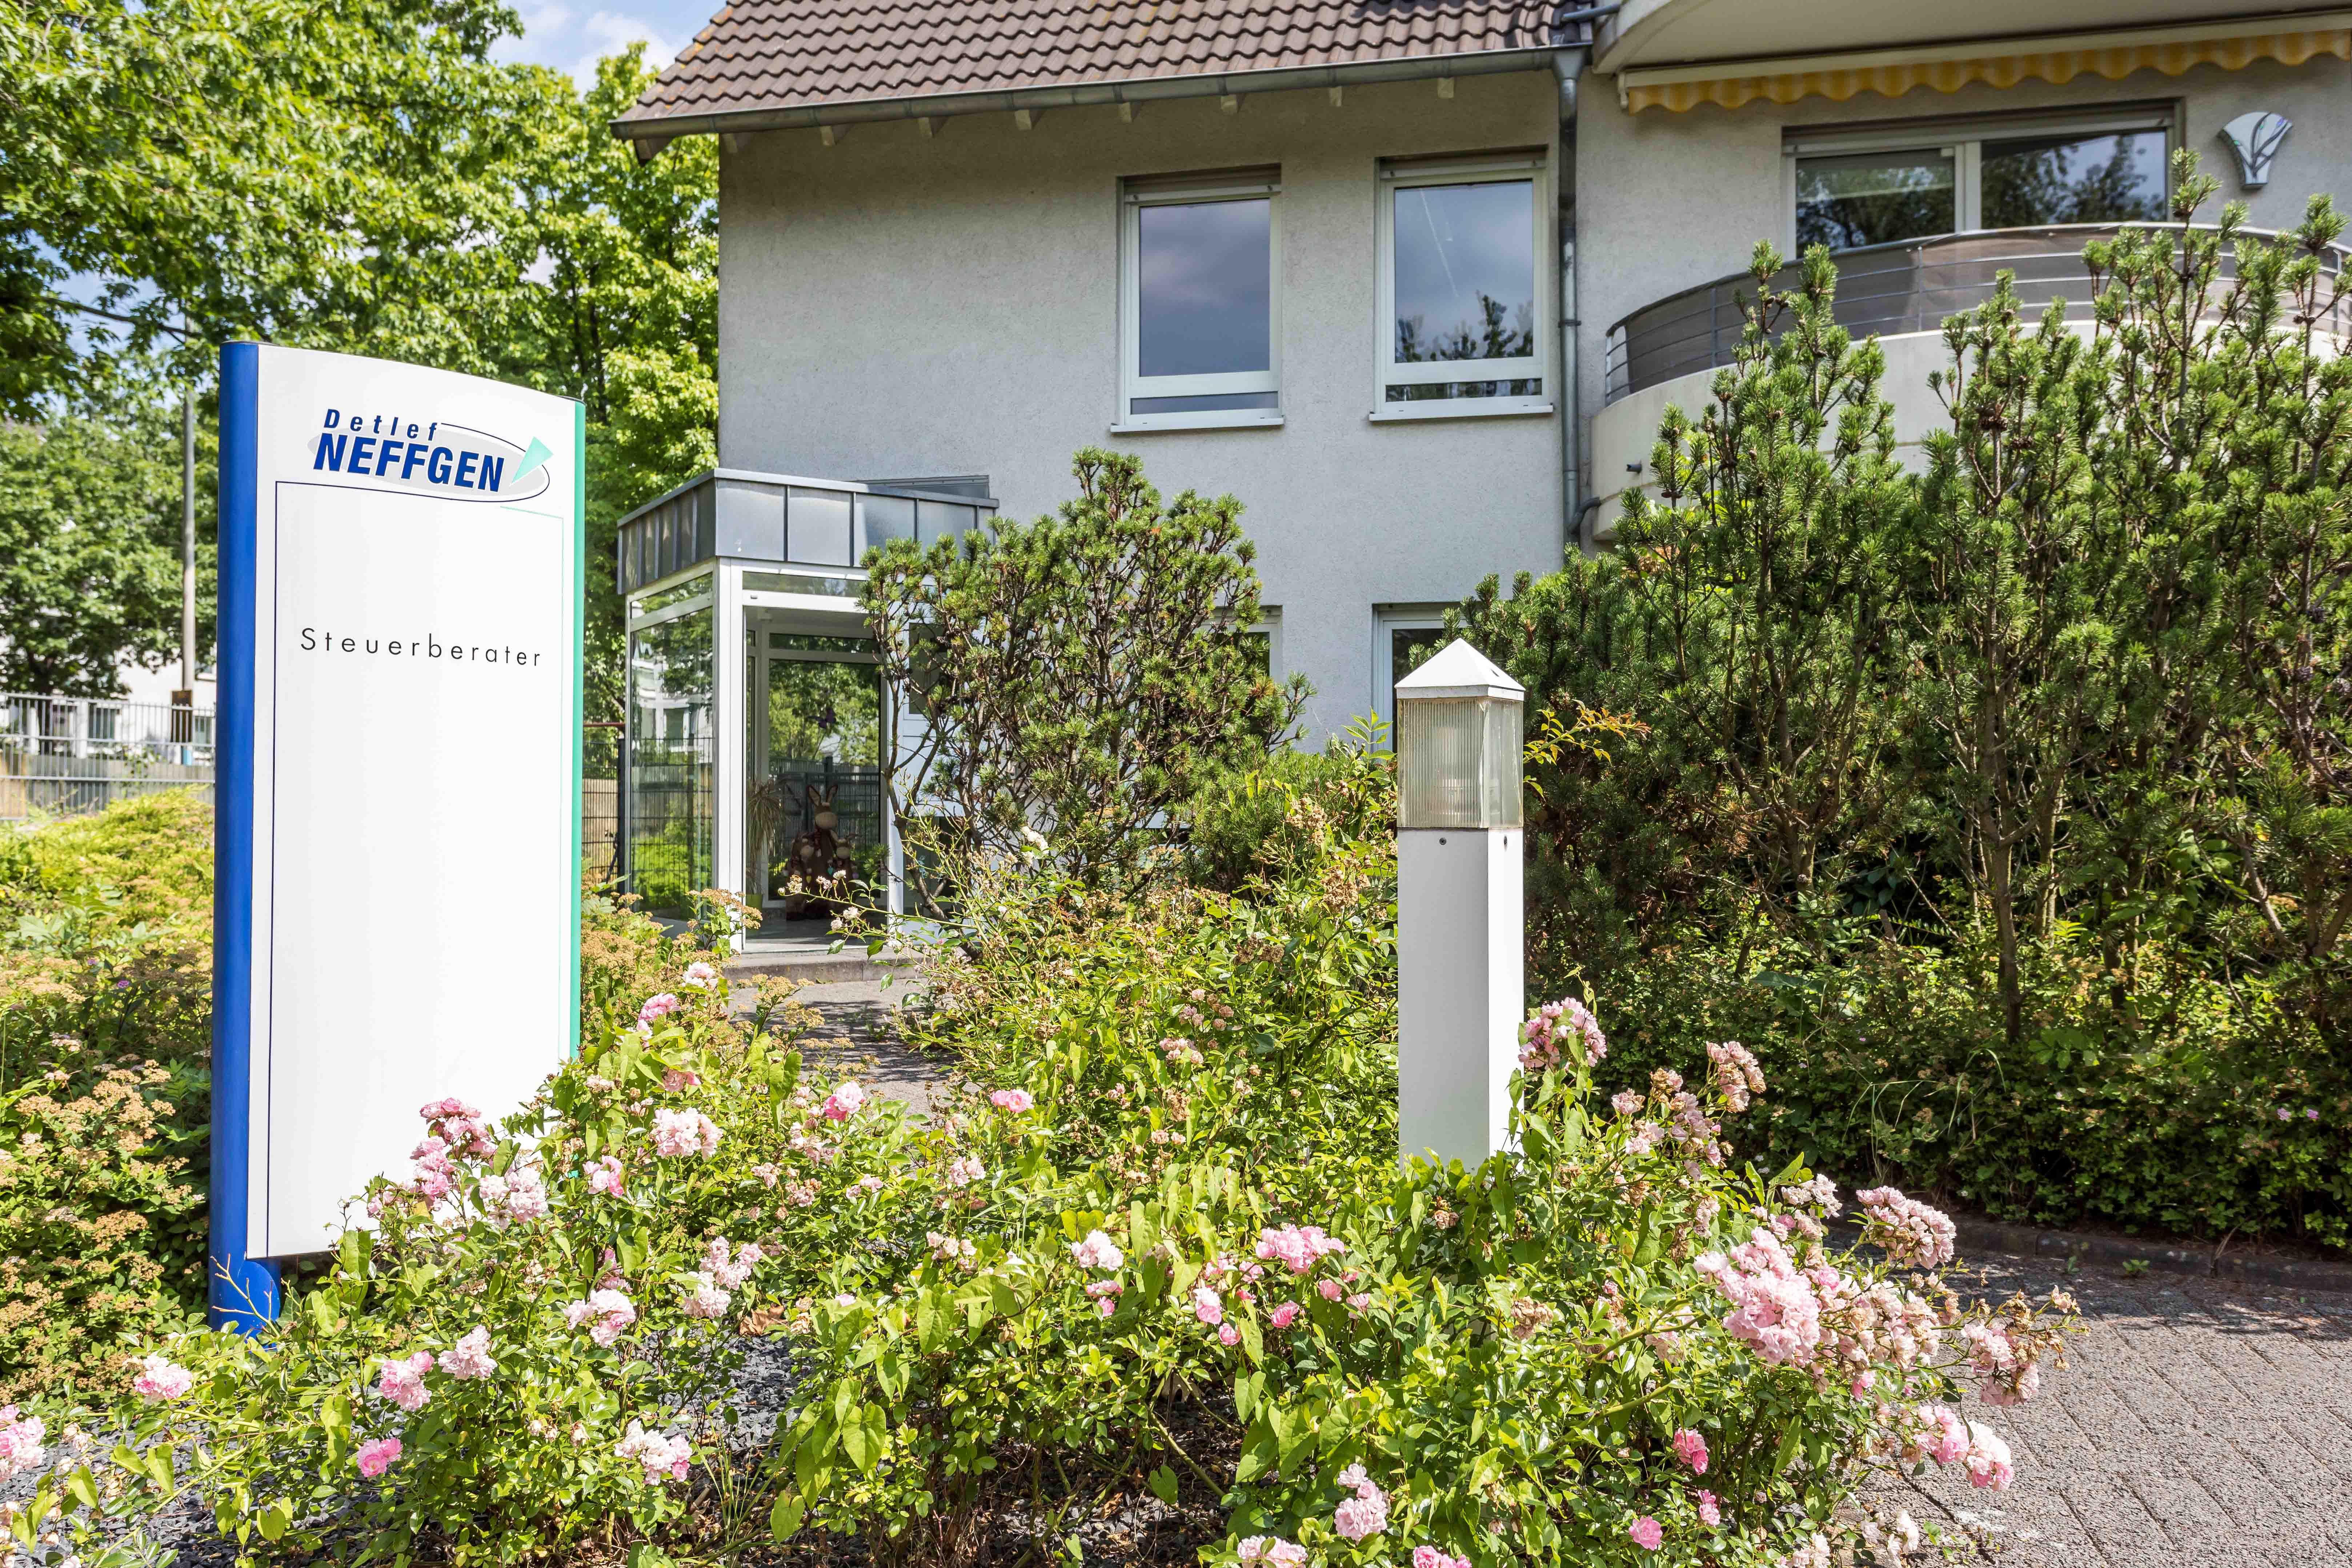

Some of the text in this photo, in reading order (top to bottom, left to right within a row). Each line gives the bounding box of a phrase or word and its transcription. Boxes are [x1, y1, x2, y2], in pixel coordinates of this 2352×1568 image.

[324, 409, 437, 441] Detlef
[313, 433, 504, 492] NEFFGEN
[300, 627, 541, 666] Steuerberater
